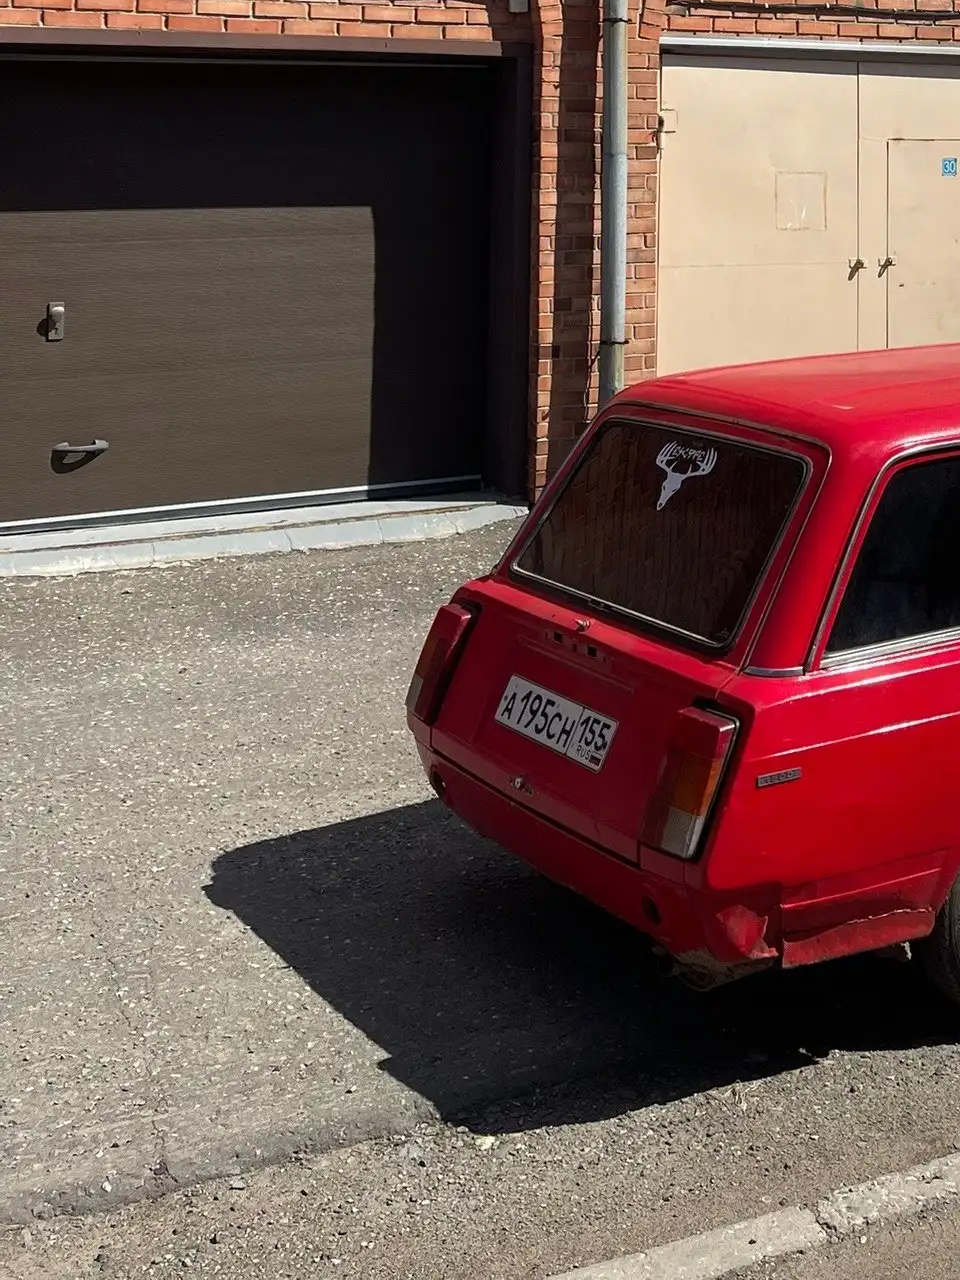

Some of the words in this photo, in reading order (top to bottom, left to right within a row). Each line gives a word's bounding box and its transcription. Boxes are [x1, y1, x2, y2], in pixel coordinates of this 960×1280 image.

[943, 160, 956, 173] 30
[579, 715, 612, 751] 155
[576, 745, 592, 760] RUS
